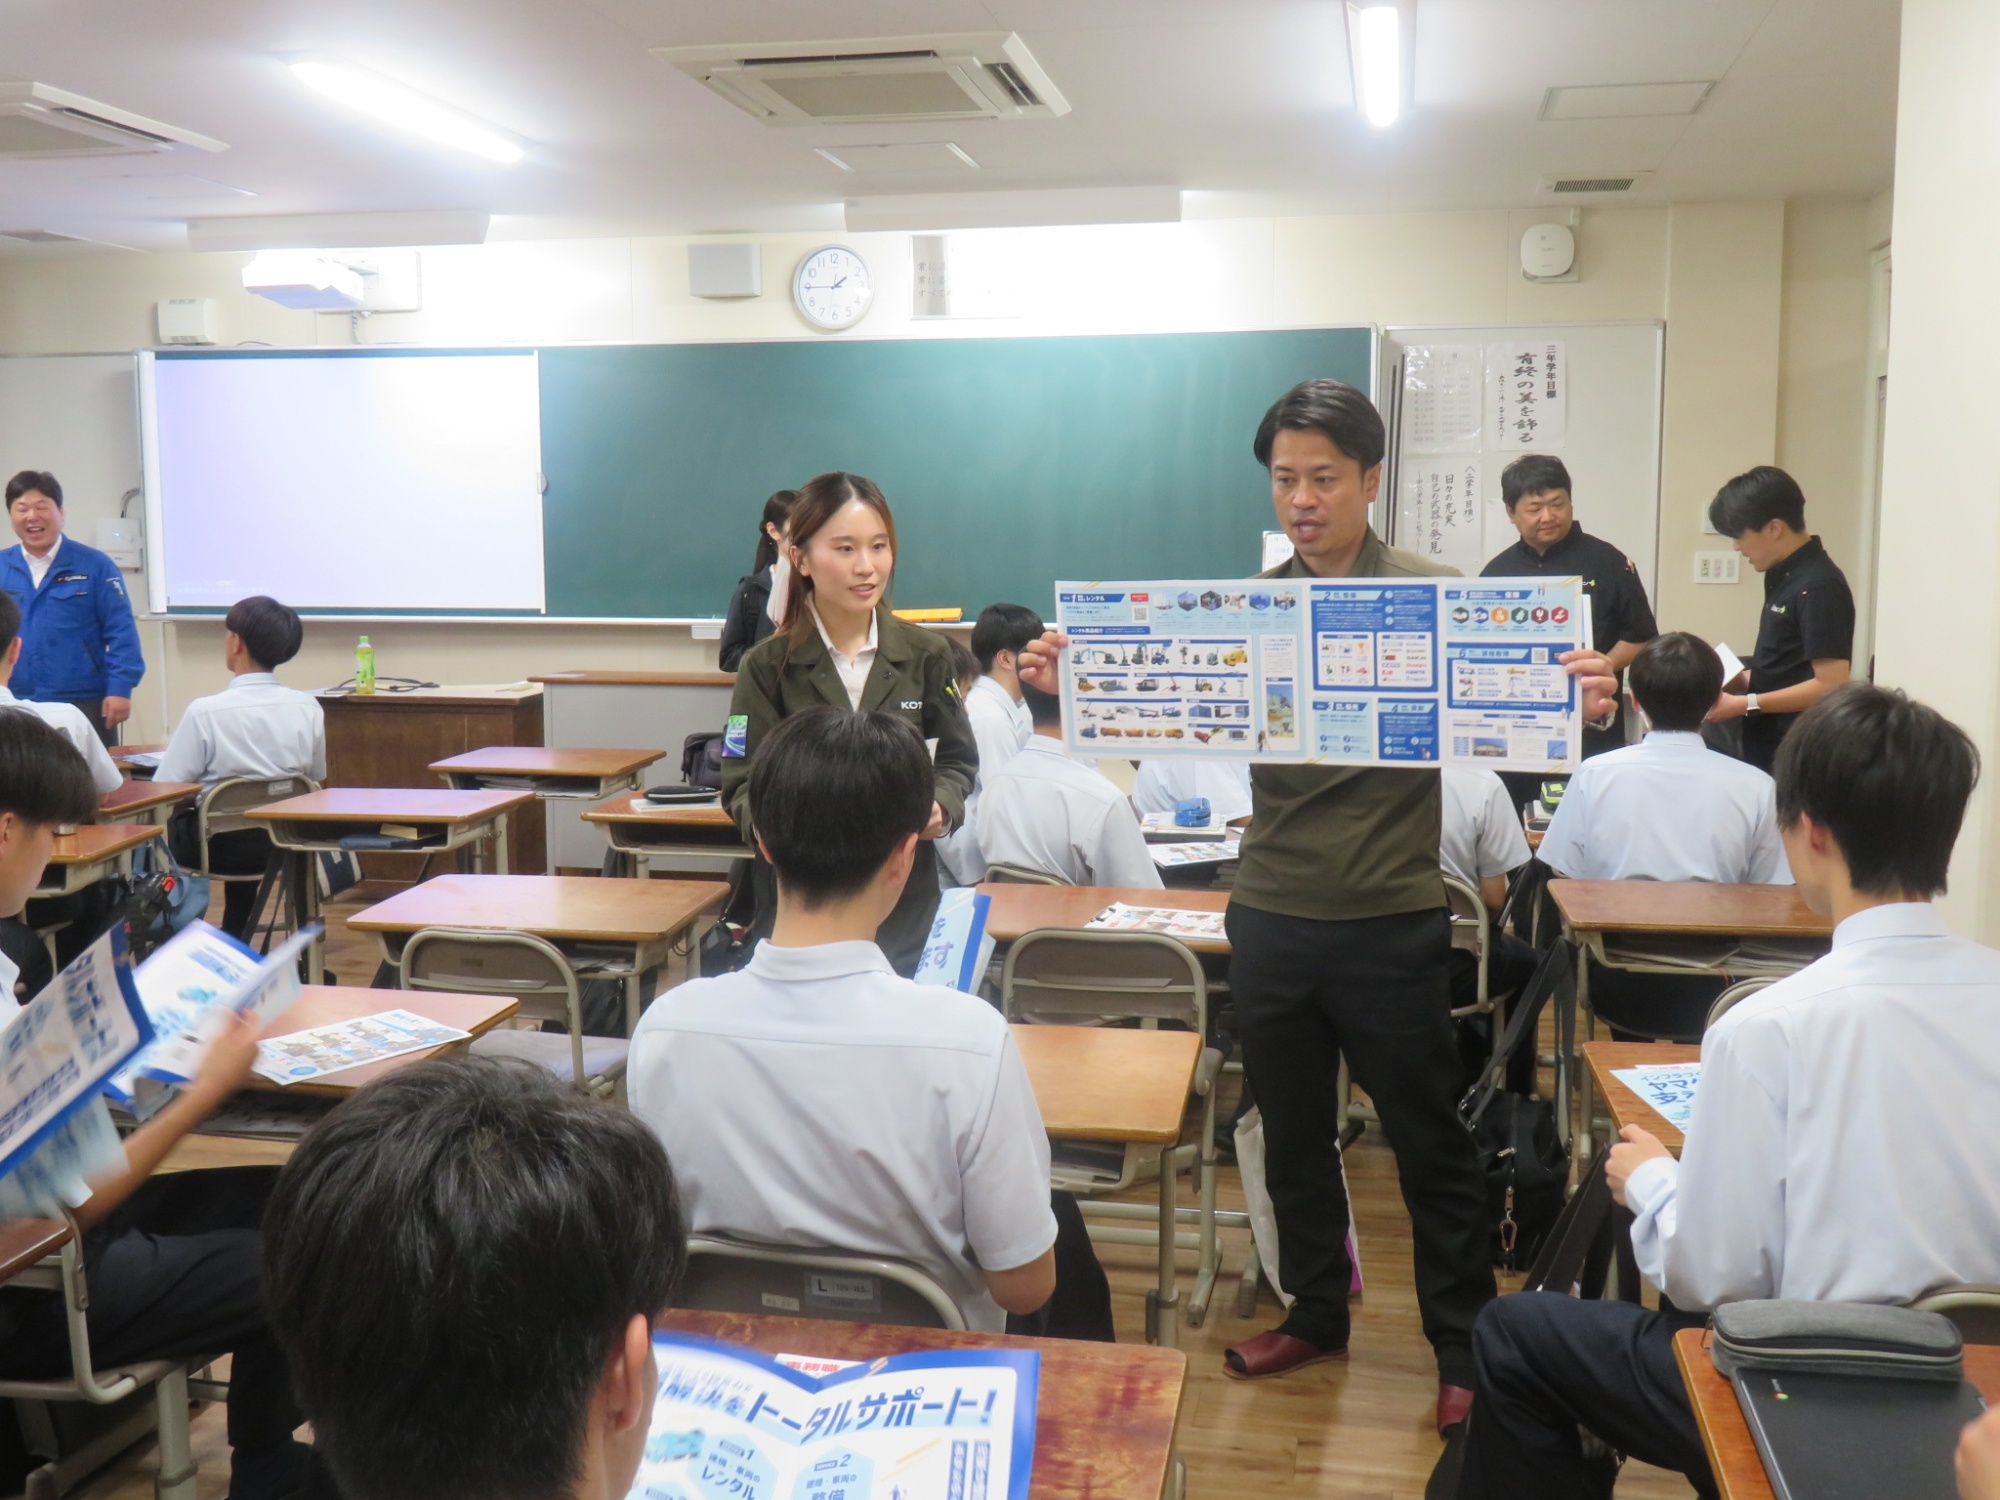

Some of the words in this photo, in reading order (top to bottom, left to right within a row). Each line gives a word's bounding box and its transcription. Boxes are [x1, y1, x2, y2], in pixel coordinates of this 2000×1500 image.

[816, 257, 825, 268] 11
[829, 253, 839, 264] 12
[807, 267, 817, 279] 10
[854, 266, 861, 277] 2
[804, 282, 812, 293] 9
[808, 296, 816, 307] 8
[853, 295, 861, 305] 4
[818, 307, 826, 317] 7
[831, 310, 839, 320] 6
[845, 306, 852, 317] 5
[1545, 344, 1557, 399] 三年学年目標
[1512, 352, 1538, 443] 有終の美を飾る
[1444, 474, 1457, 527] 日々の充実
[1429, 472, 1444, 555] 自己の武器の発見
[1647, 1078, 1700, 1091] ヤマ
[817, 1278, 828, 1293] L
[839, 1453, 852, 1467] 2
